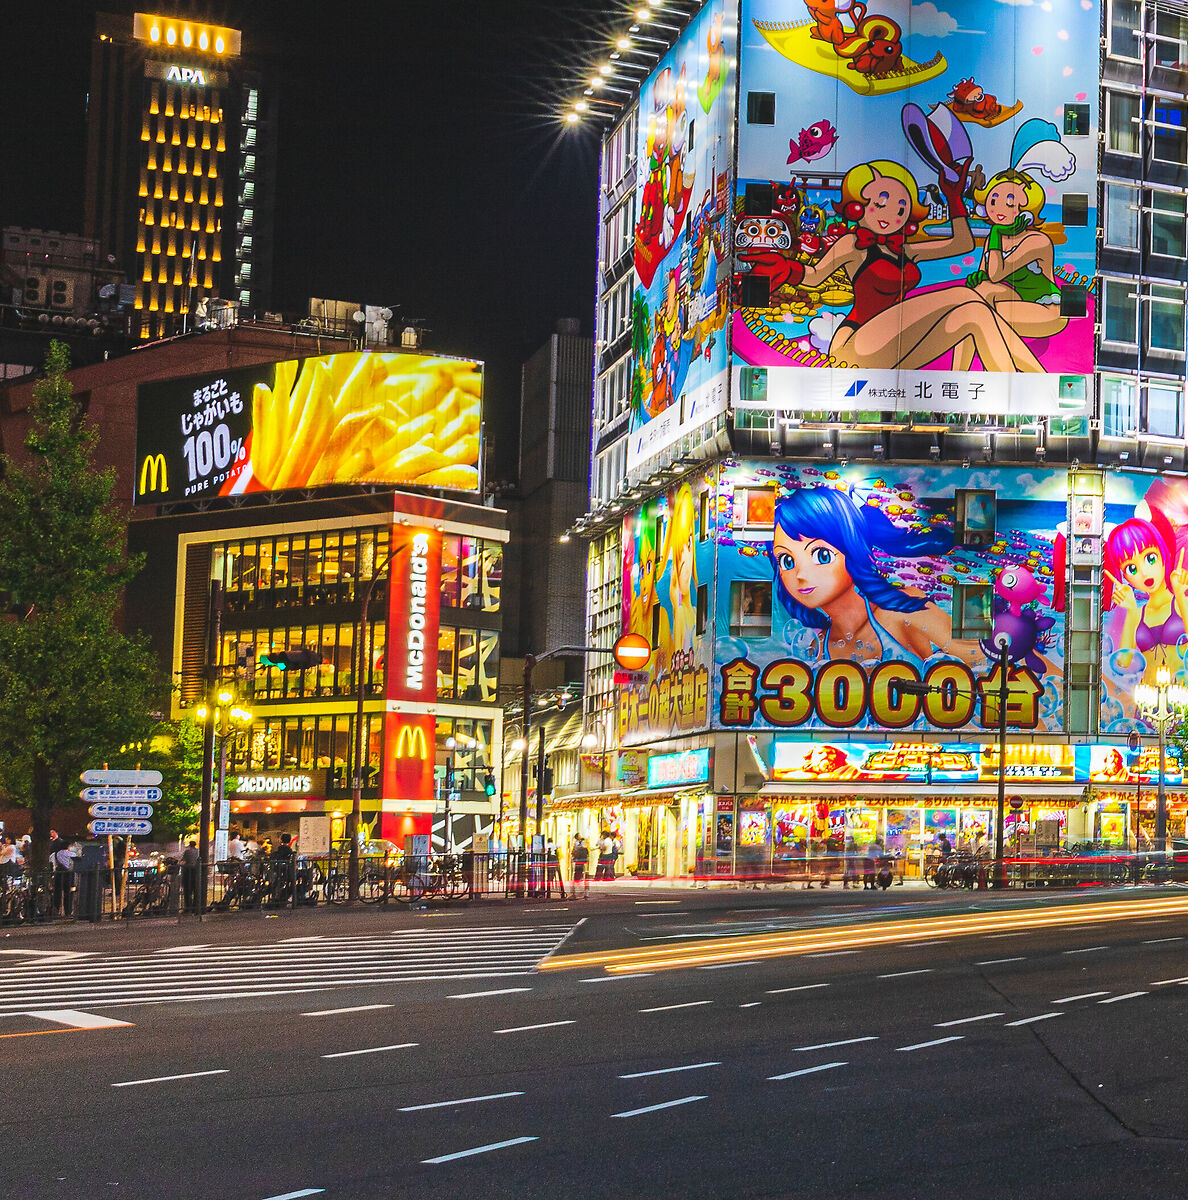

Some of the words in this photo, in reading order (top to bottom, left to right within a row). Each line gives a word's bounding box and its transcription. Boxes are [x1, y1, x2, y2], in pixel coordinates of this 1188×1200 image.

[166, 65, 206, 85] APA
[193, 379, 228, 407] まるごと
[868, 388, 906, 398] 株式会社
[914, 381, 986, 400] 北電子
[181, 391, 244, 435] じゃがいも
[183, 423, 246, 482] 100%
[185, 479, 209, 496] PURE
[406, 533, 429, 691] McDonald's
[720, 659, 759, 725] 合計
[760, 659, 1044, 729] 3000台
[236, 775, 311, 793] McDonald's
